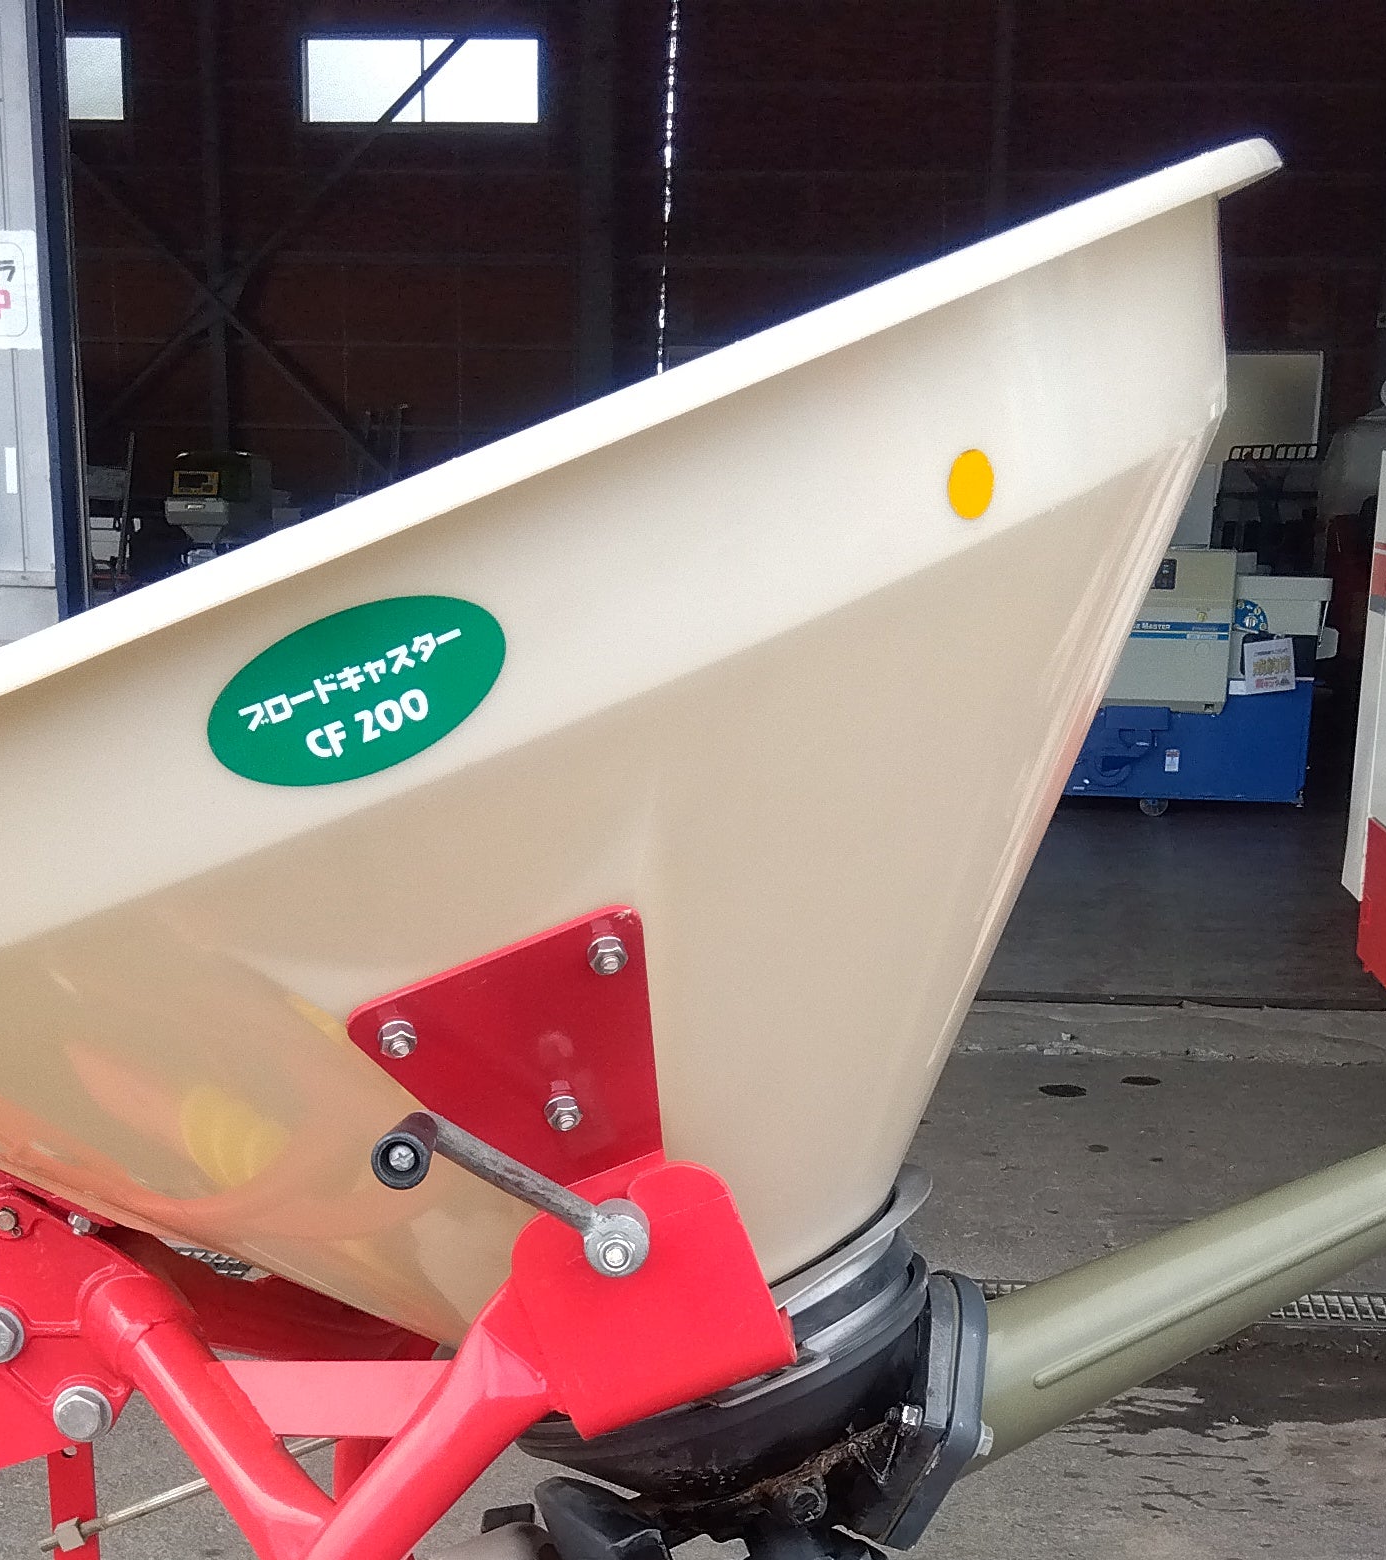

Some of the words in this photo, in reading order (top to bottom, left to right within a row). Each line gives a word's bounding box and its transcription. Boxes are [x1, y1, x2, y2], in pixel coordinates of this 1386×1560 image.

[238, 628, 462, 732] ブロードキャスター
[305, 720, 347, 758] CF
[354, 688, 429, 744] 200
